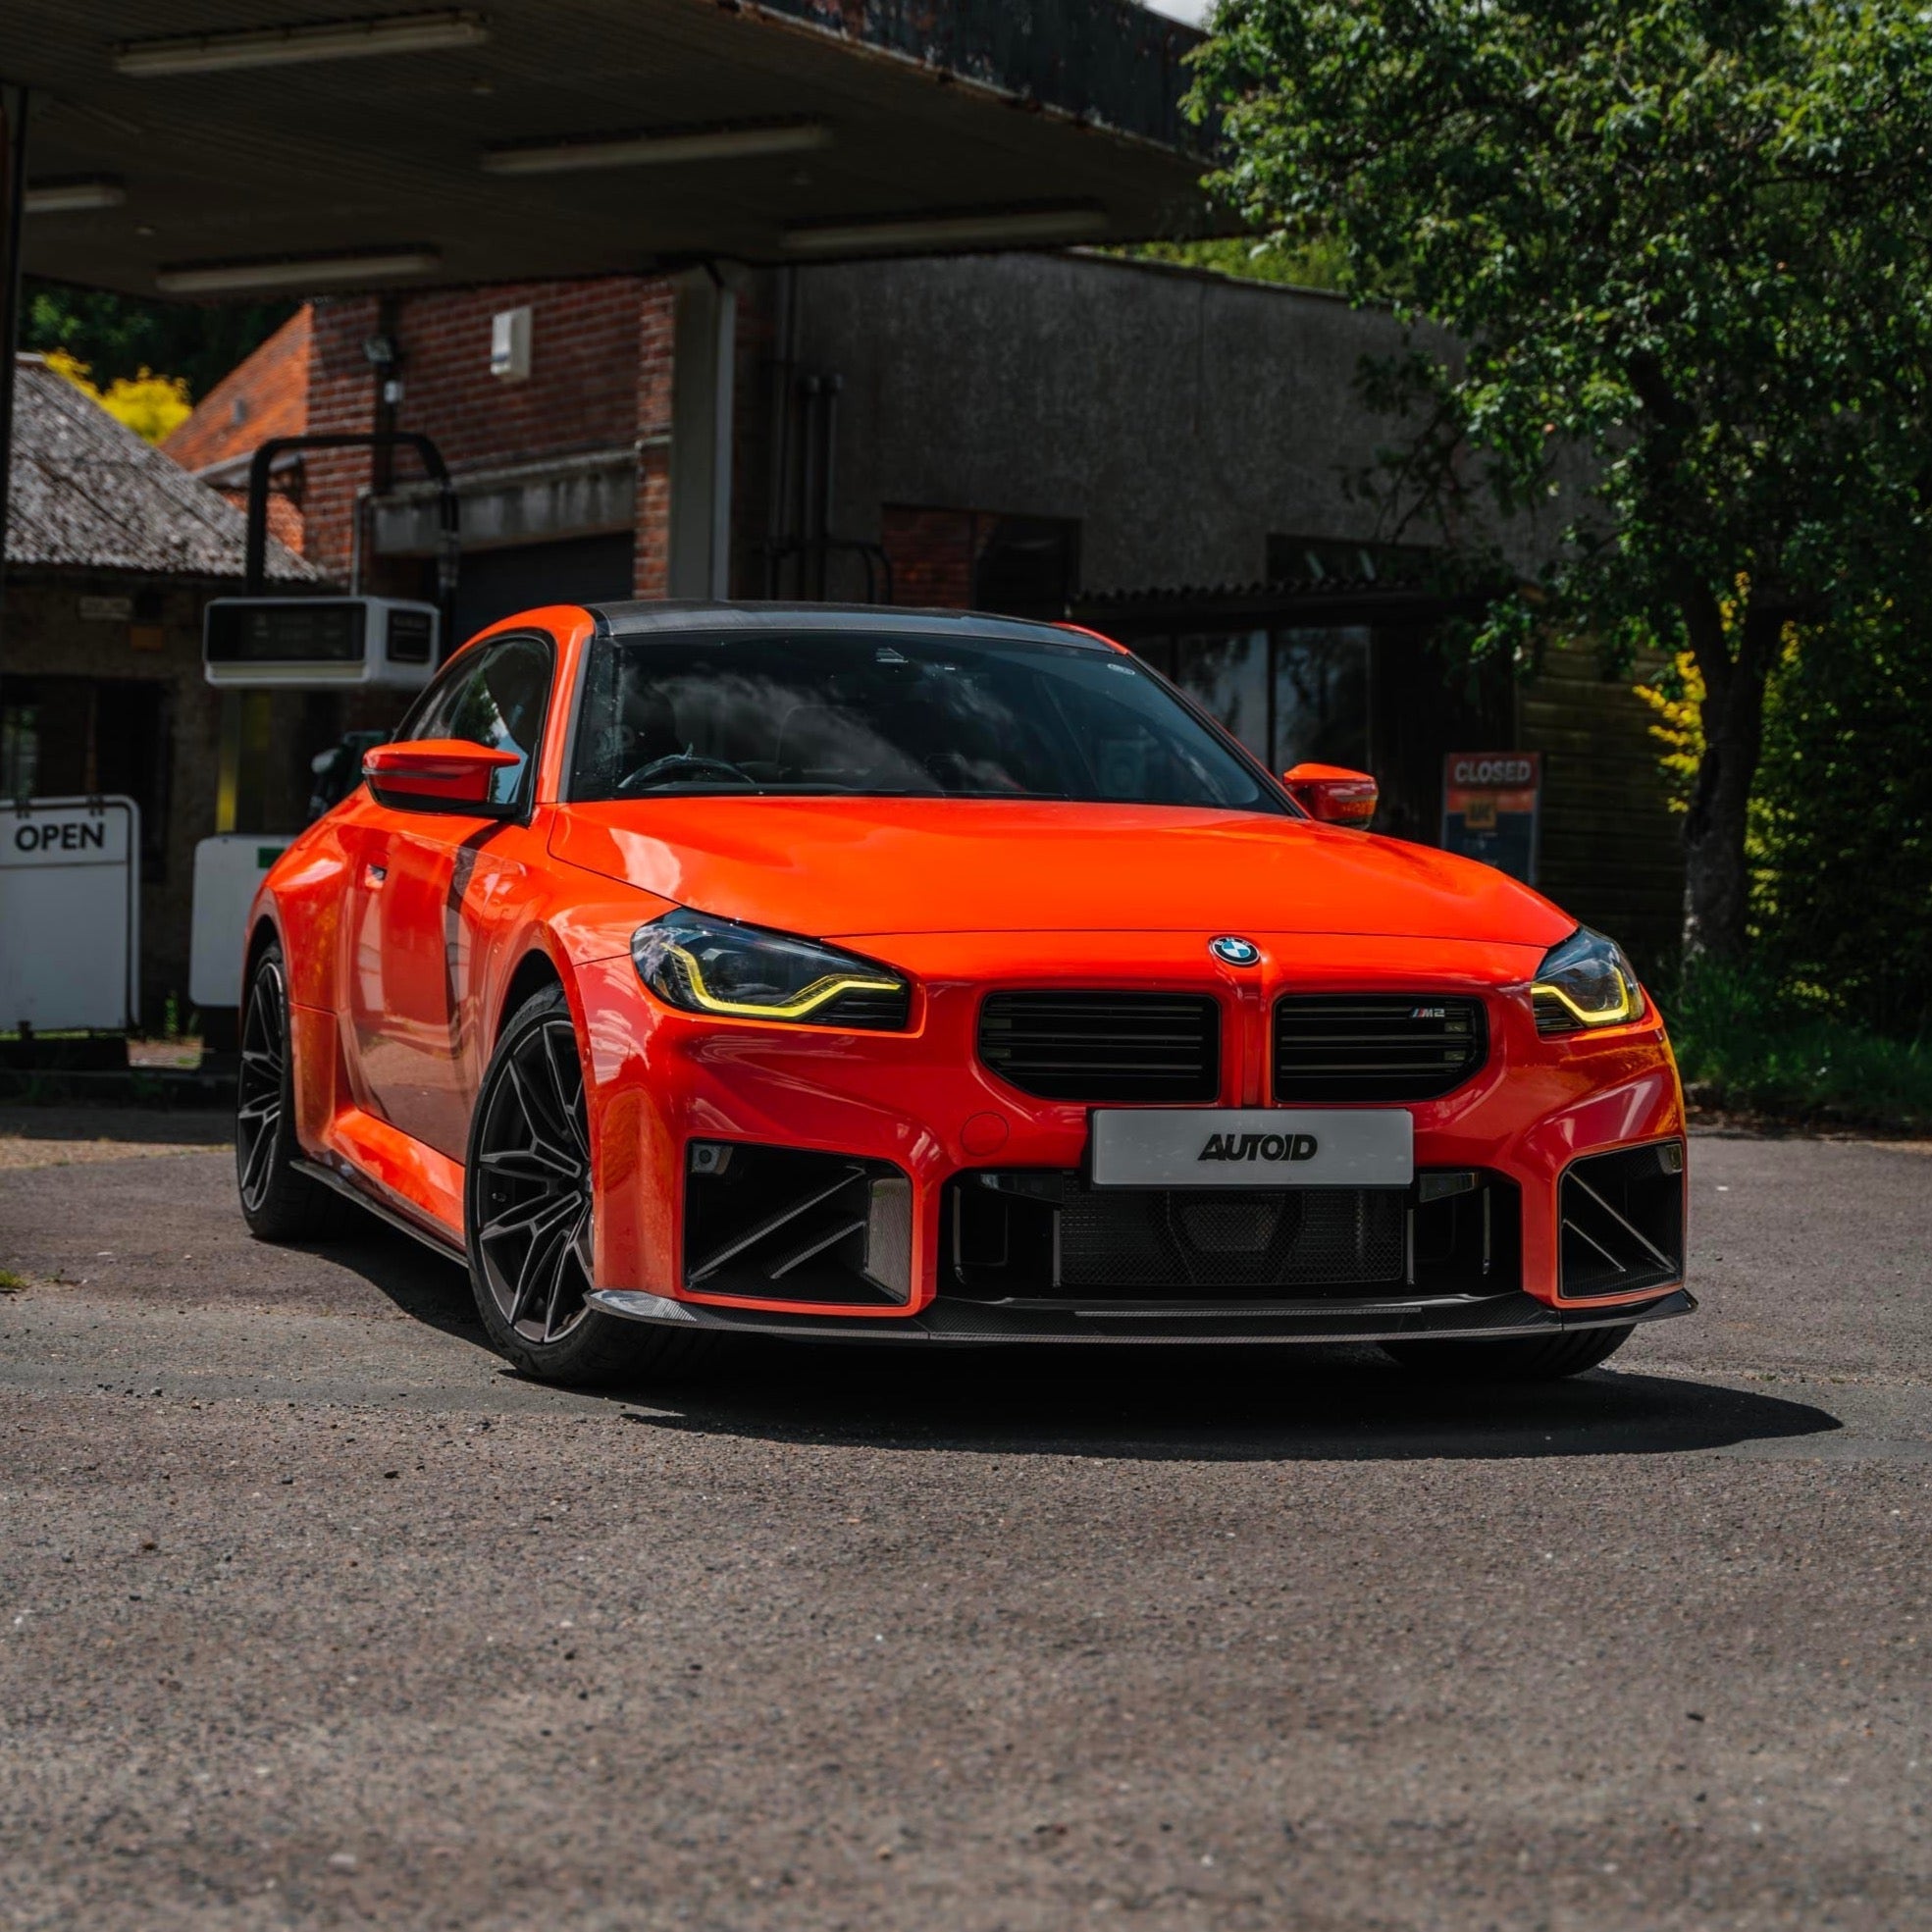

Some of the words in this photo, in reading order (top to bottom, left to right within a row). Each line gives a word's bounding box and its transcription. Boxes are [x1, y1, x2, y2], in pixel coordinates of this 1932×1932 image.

[1454, 759, 1531, 783] CLOSED
[15, 822, 105, 852] OPEN
[1197, 1134, 1318, 1161] AUTOID
